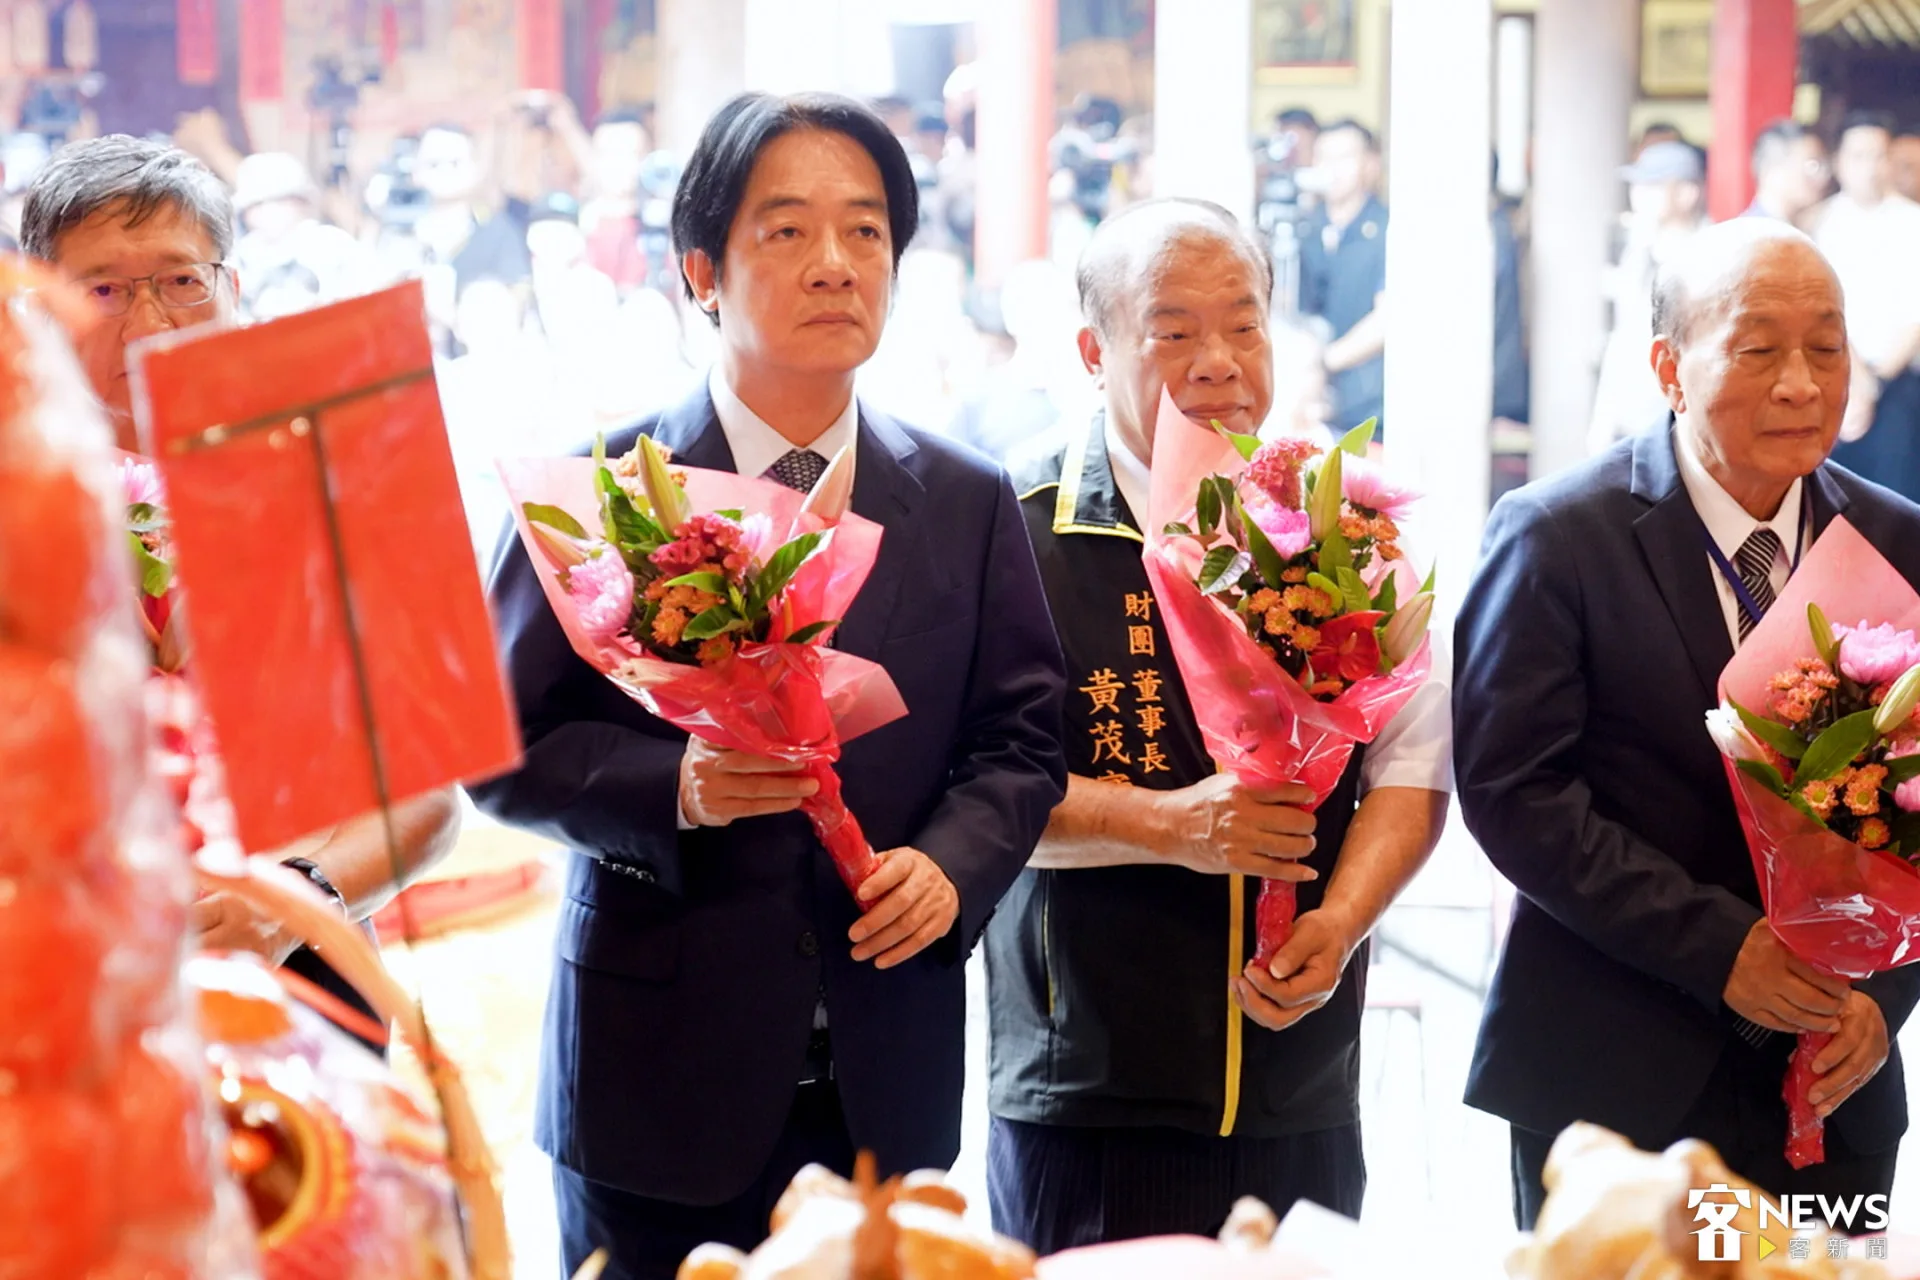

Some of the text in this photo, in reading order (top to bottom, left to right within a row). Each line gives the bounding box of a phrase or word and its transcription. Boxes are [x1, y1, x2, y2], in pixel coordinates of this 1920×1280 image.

[1124, 590, 1171, 774] 財團 董事長
